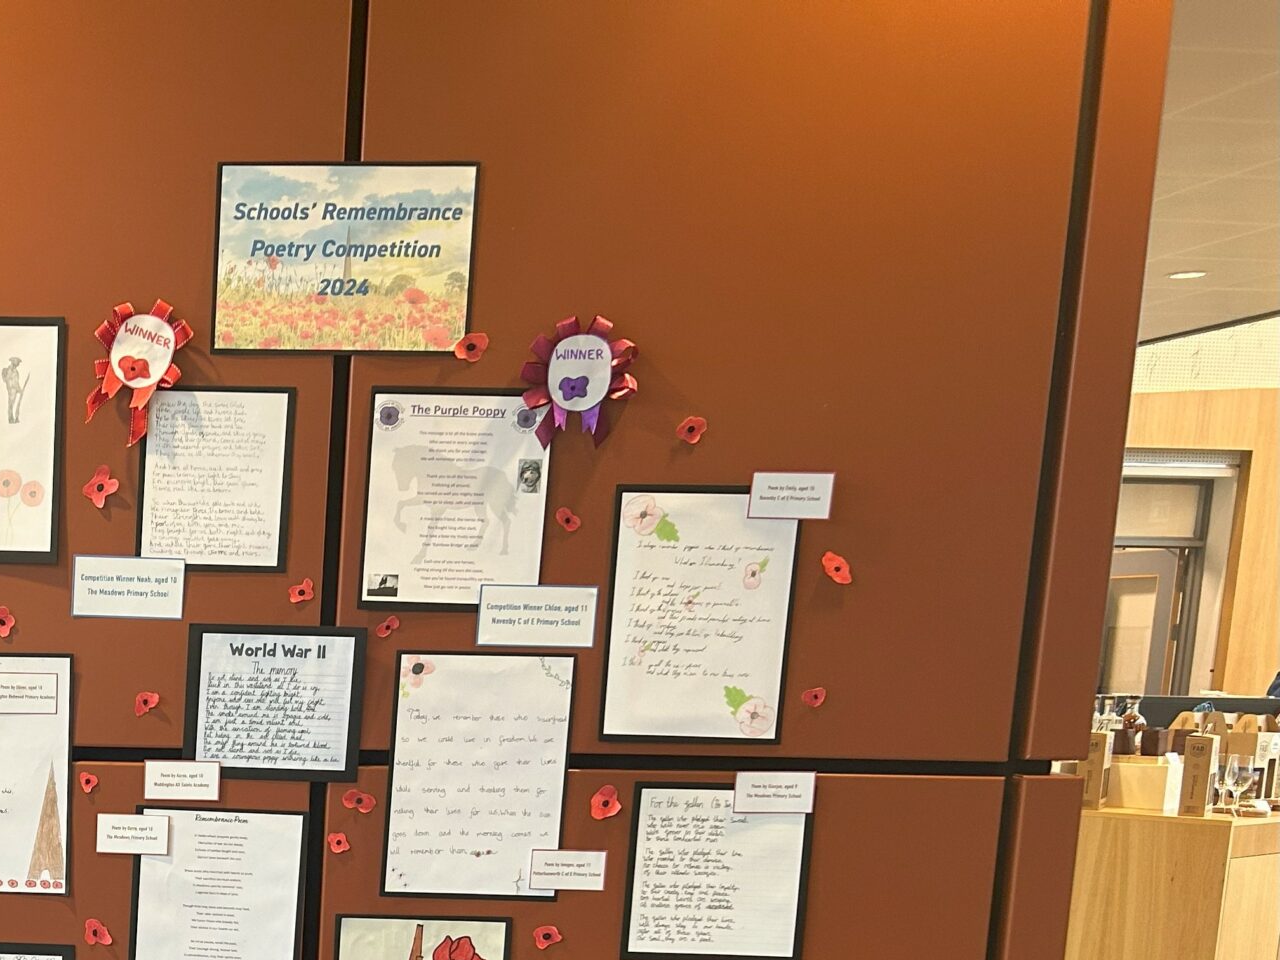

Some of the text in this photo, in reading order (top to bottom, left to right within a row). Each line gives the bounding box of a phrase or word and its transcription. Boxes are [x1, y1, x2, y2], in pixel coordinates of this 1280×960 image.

[322, 203, 463, 221] Remembrance
[250, 240, 441, 262] Poetry Competition
[318, 279, 369, 297] 2024
[124, 322, 171, 350] WINNER
[555, 348, 604, 360] WINNER
[411, 405, 507, 418] The Purple Poppy
[80, 574, 115, 583] Competition
[115, 575, 135, 583] Winner
[154, 577, 168, 585] aged
[99, 588, 125, 596] Meadows
[126, 589, 148, 599] Primary
[486, 602, 522, 612] Competition
[522, 603, 543, 611] Winner
[564, 605, 578, 613] aged
[536, 618, 559, 628] Primary
[229, 642, 277, 658] World
[281, 644, 312, 658] War
[252, 661, 298, 676] The memory
[456, 784, 471, 793] and
[195, 814, 233, 823] Remembrance
